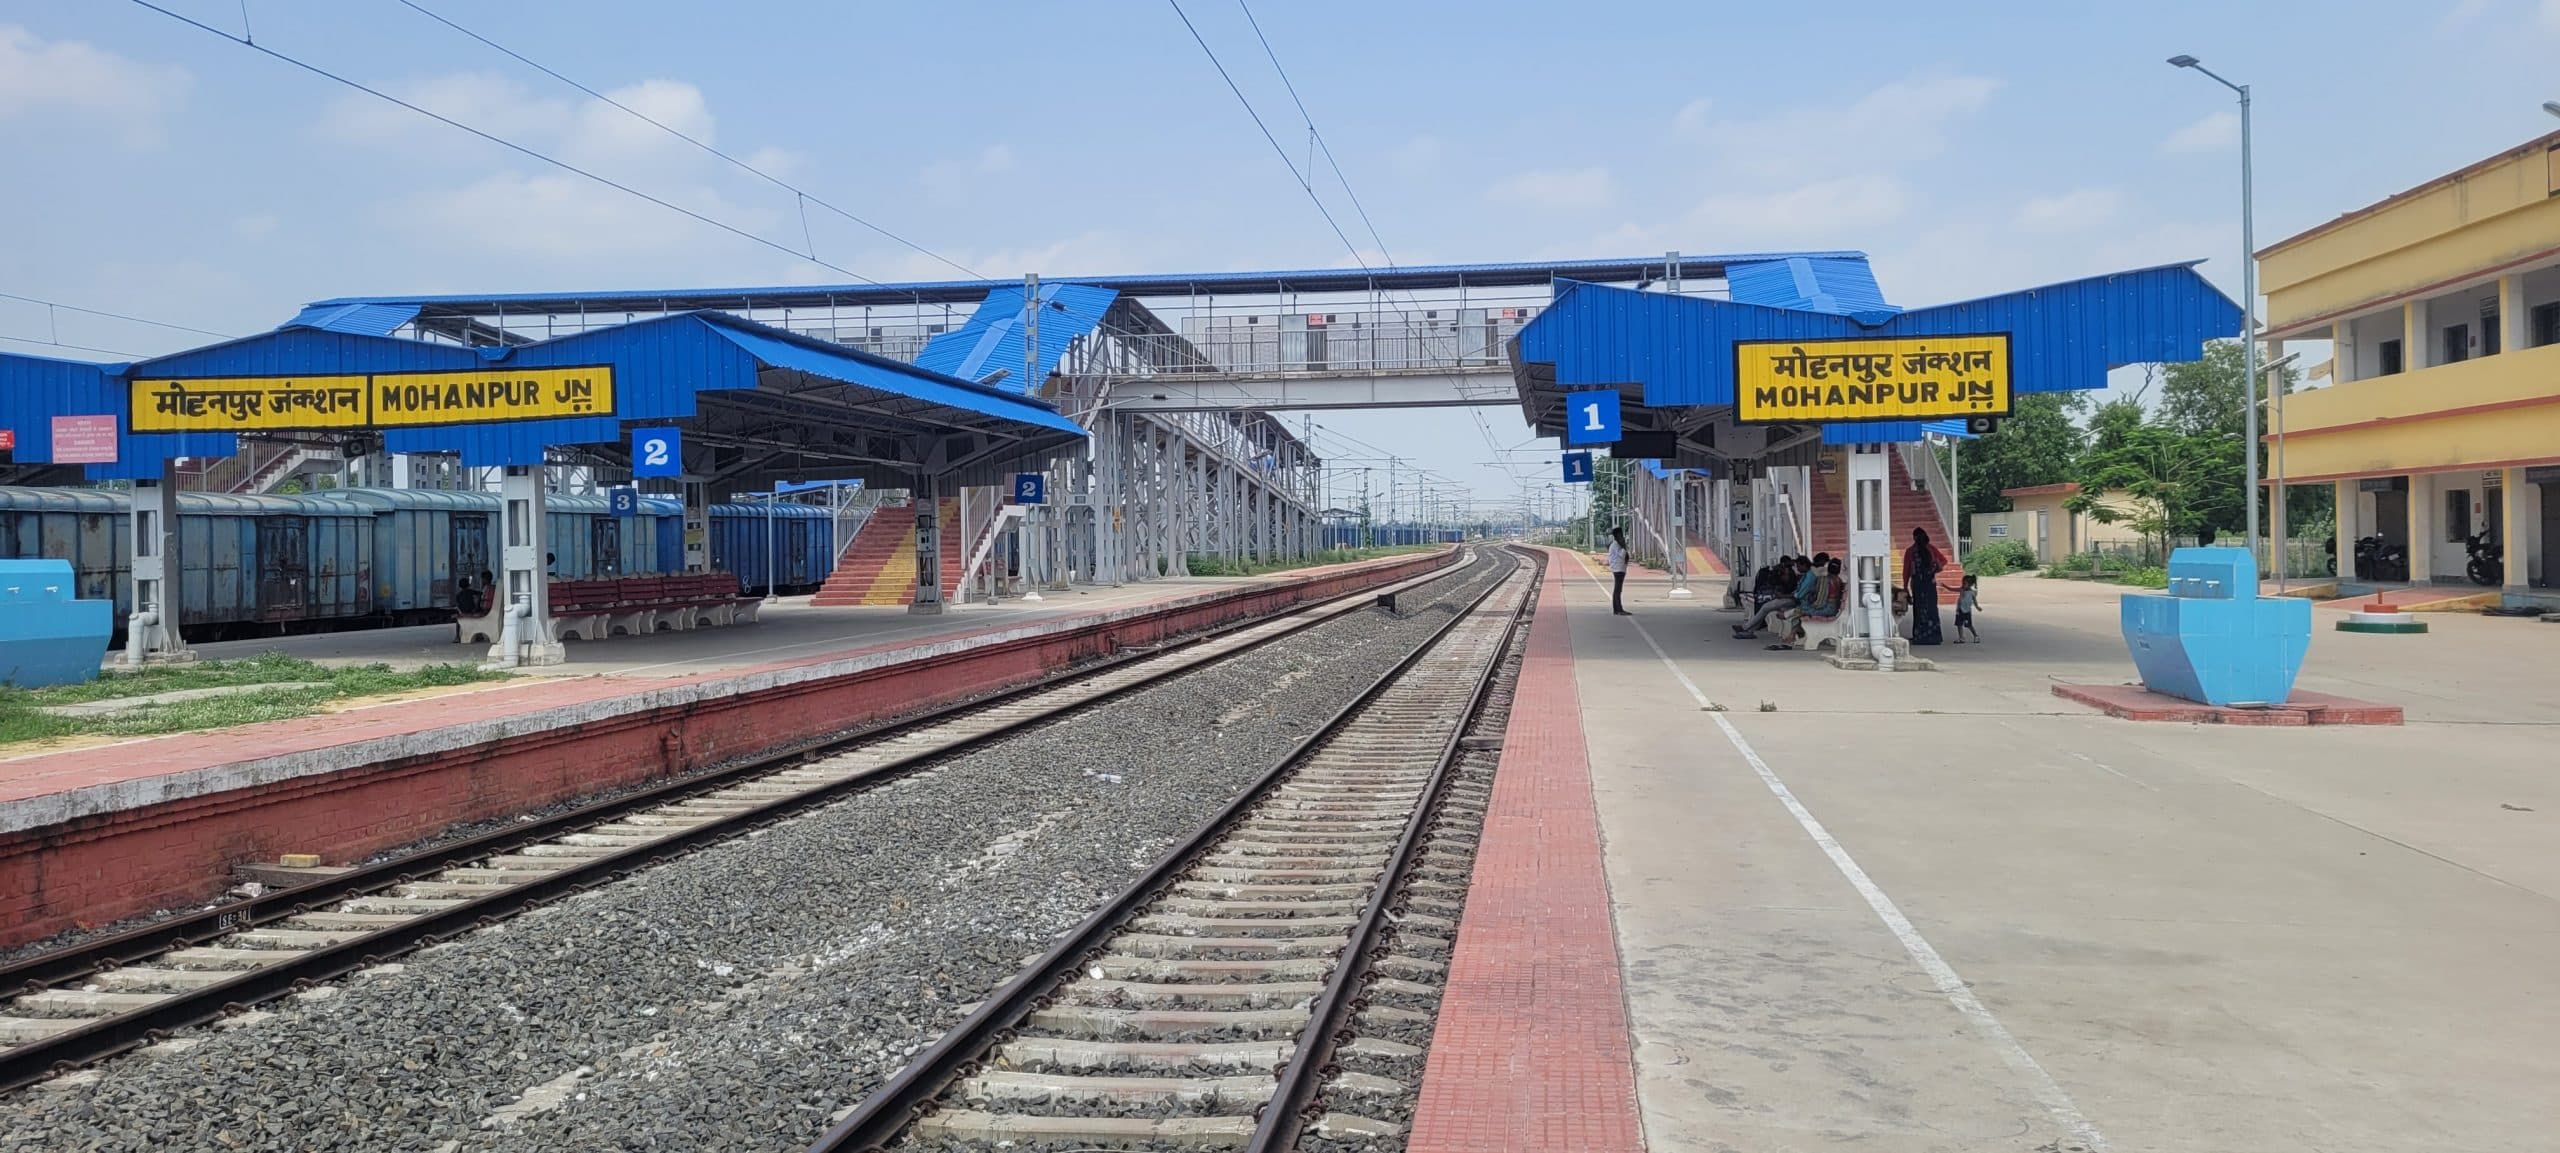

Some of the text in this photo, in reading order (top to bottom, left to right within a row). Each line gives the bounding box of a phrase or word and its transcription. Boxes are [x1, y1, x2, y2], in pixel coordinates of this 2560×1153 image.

[1770, 345, 1993, 383] मोहनपुर जंक्शन
[151, 381, 361, 421] मोहनपुर जंक्शन
[382, 381, 540, 412] MOHANPUR
[1756, 382, 1939, 408] MOHANPUR
[1584, 403, 1605, 430] 1
[644, 439, 668, 465] 2
[1572, 460, 1584, 475] 1
[1021, 482, 1036, 496] 2
[617, 495, 630, 510] 3
